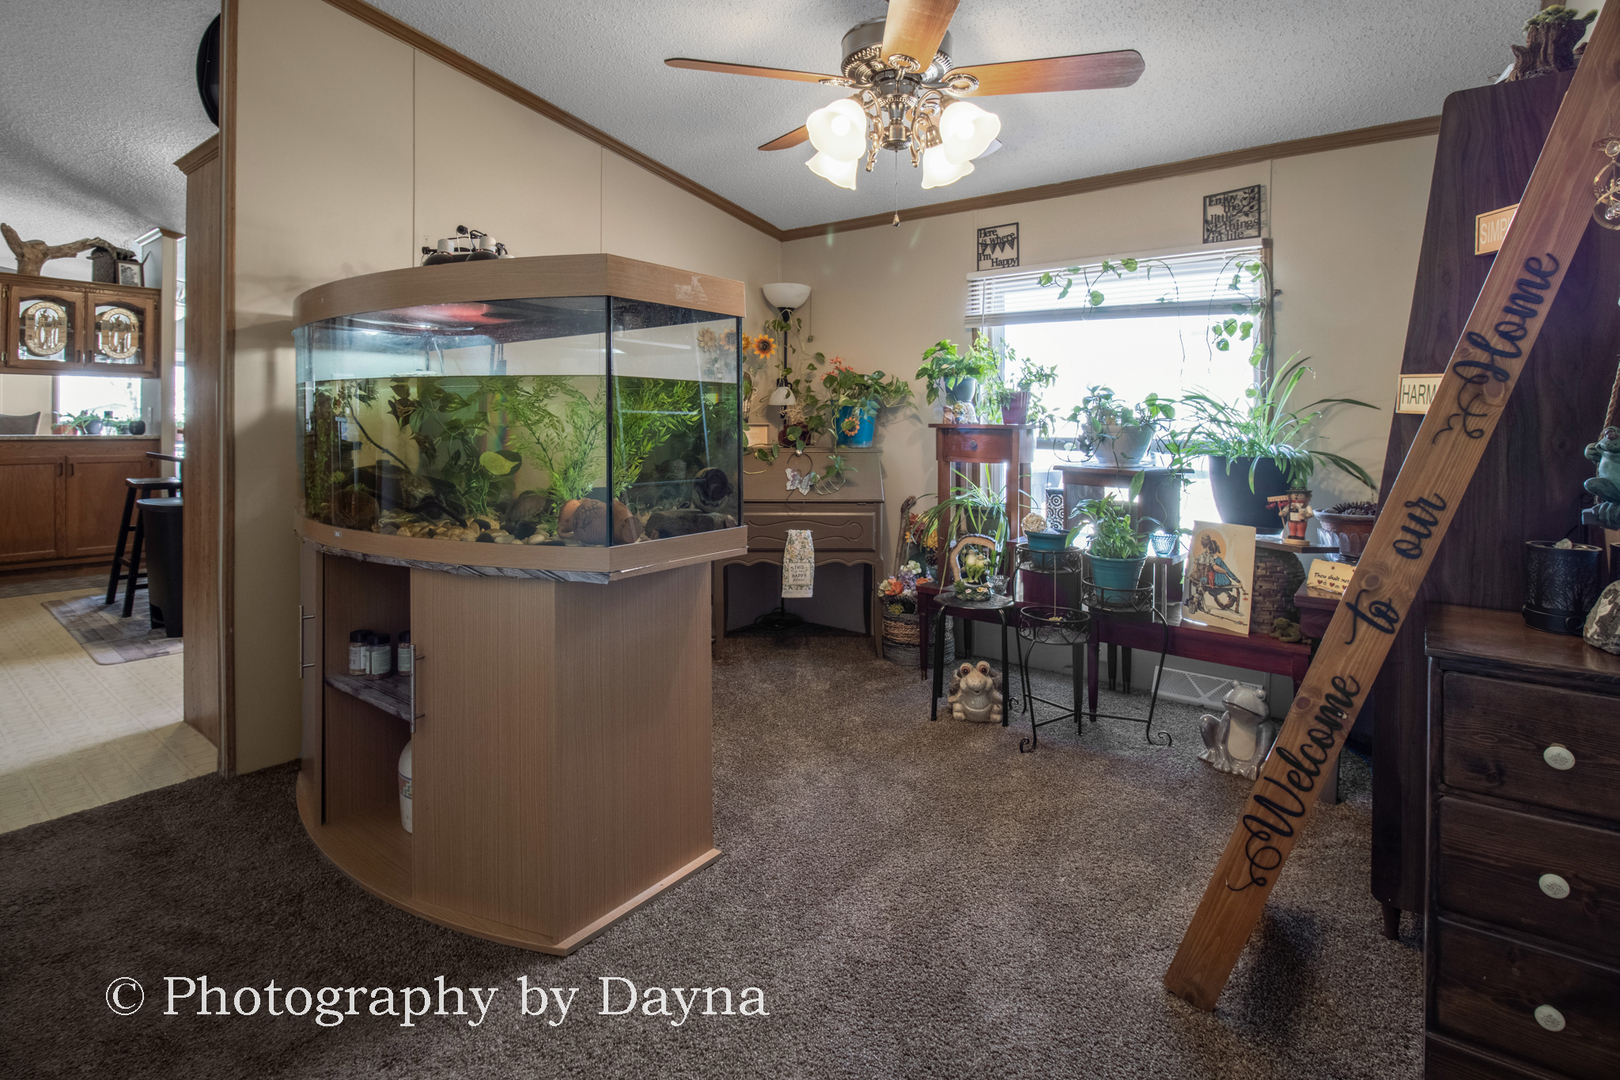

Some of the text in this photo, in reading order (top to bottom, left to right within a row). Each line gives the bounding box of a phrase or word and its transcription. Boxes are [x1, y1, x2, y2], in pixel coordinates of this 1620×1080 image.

[1208, 194, 1238, 206] Enjoy
[1224, 202, 1240, 213] the
[1210, 212, 1234, 224] little
[1224, 219, 1259, 231] things
[979, 229, 997, 238] Here
[978, 252, 991, 261] I'm
[991, 257, 1018, 268] Happy
[1225, 674, 1361, 891] Welcome
[1344, 588, 1400, 645] to
[1393, 492, 1447, 560] our
